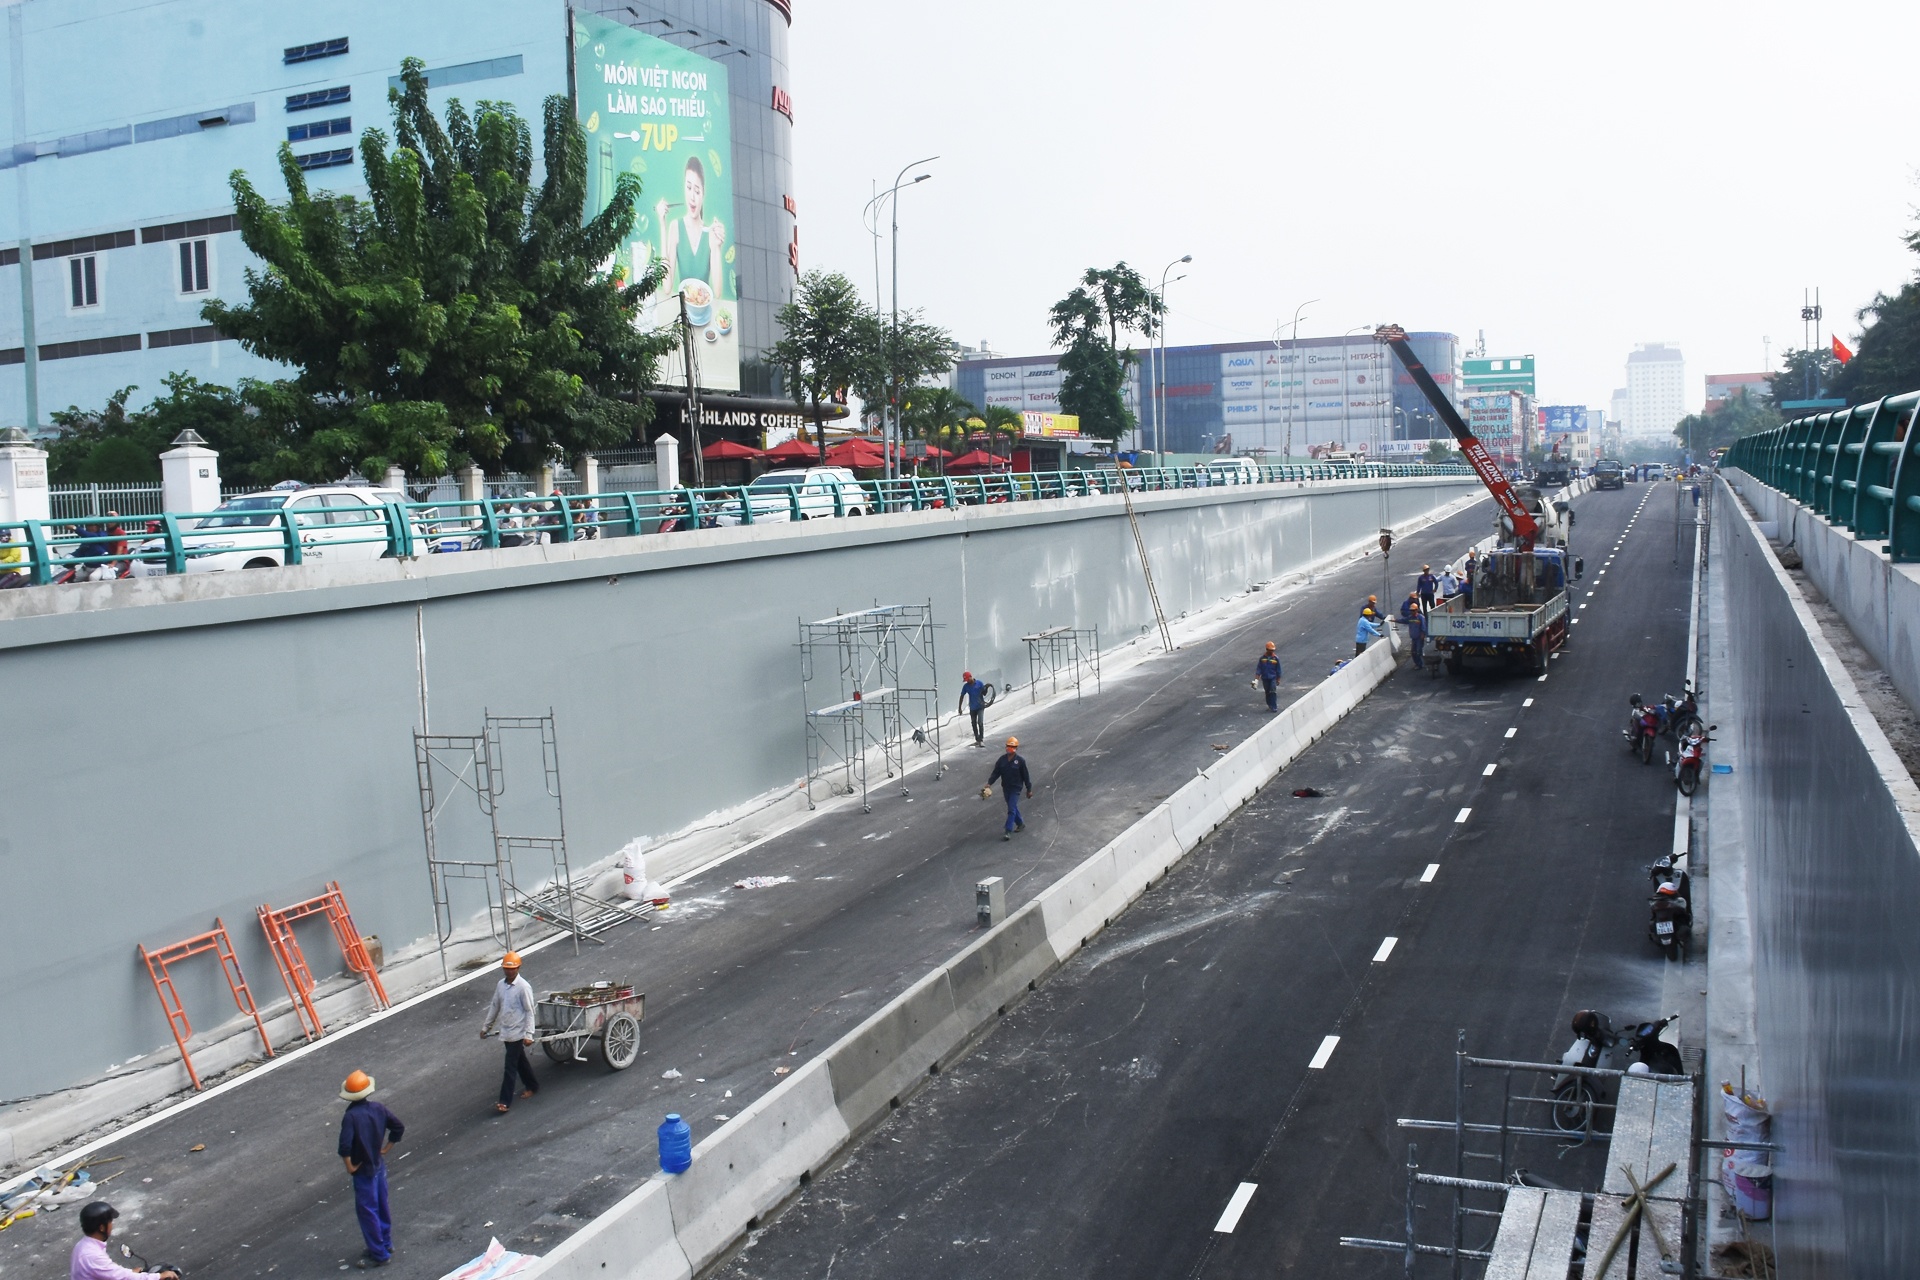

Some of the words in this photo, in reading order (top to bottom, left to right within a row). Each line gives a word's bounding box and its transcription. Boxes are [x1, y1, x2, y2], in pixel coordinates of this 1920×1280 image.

[604, 60, 638, 86] MÓN
[640, 64, 669, 93] VIỆT
[672, 70, 707, 91] NGON
[607, 88, 638, 114] LÀM
[640, 96, 667, 116] SAO
[669, 91, 705, 118] THIẾU
[641, 122, 678, 152] 7UP
[1228, 358, 1254, 367] AQUA
[1350, 352, 1385, 361] HITACHI
[990, 371, 1016, 380] DENON
[1028, 392, 1054, 401] Tefal
[760, 413, 804, 428] COFFEE
[1471, 443, 1488, 460] PHI
[1482, 459, 1504, 483] LONG
[1505, 488, 1518, 505] UNIC
[1452, 620, 1465, 629] 43C
